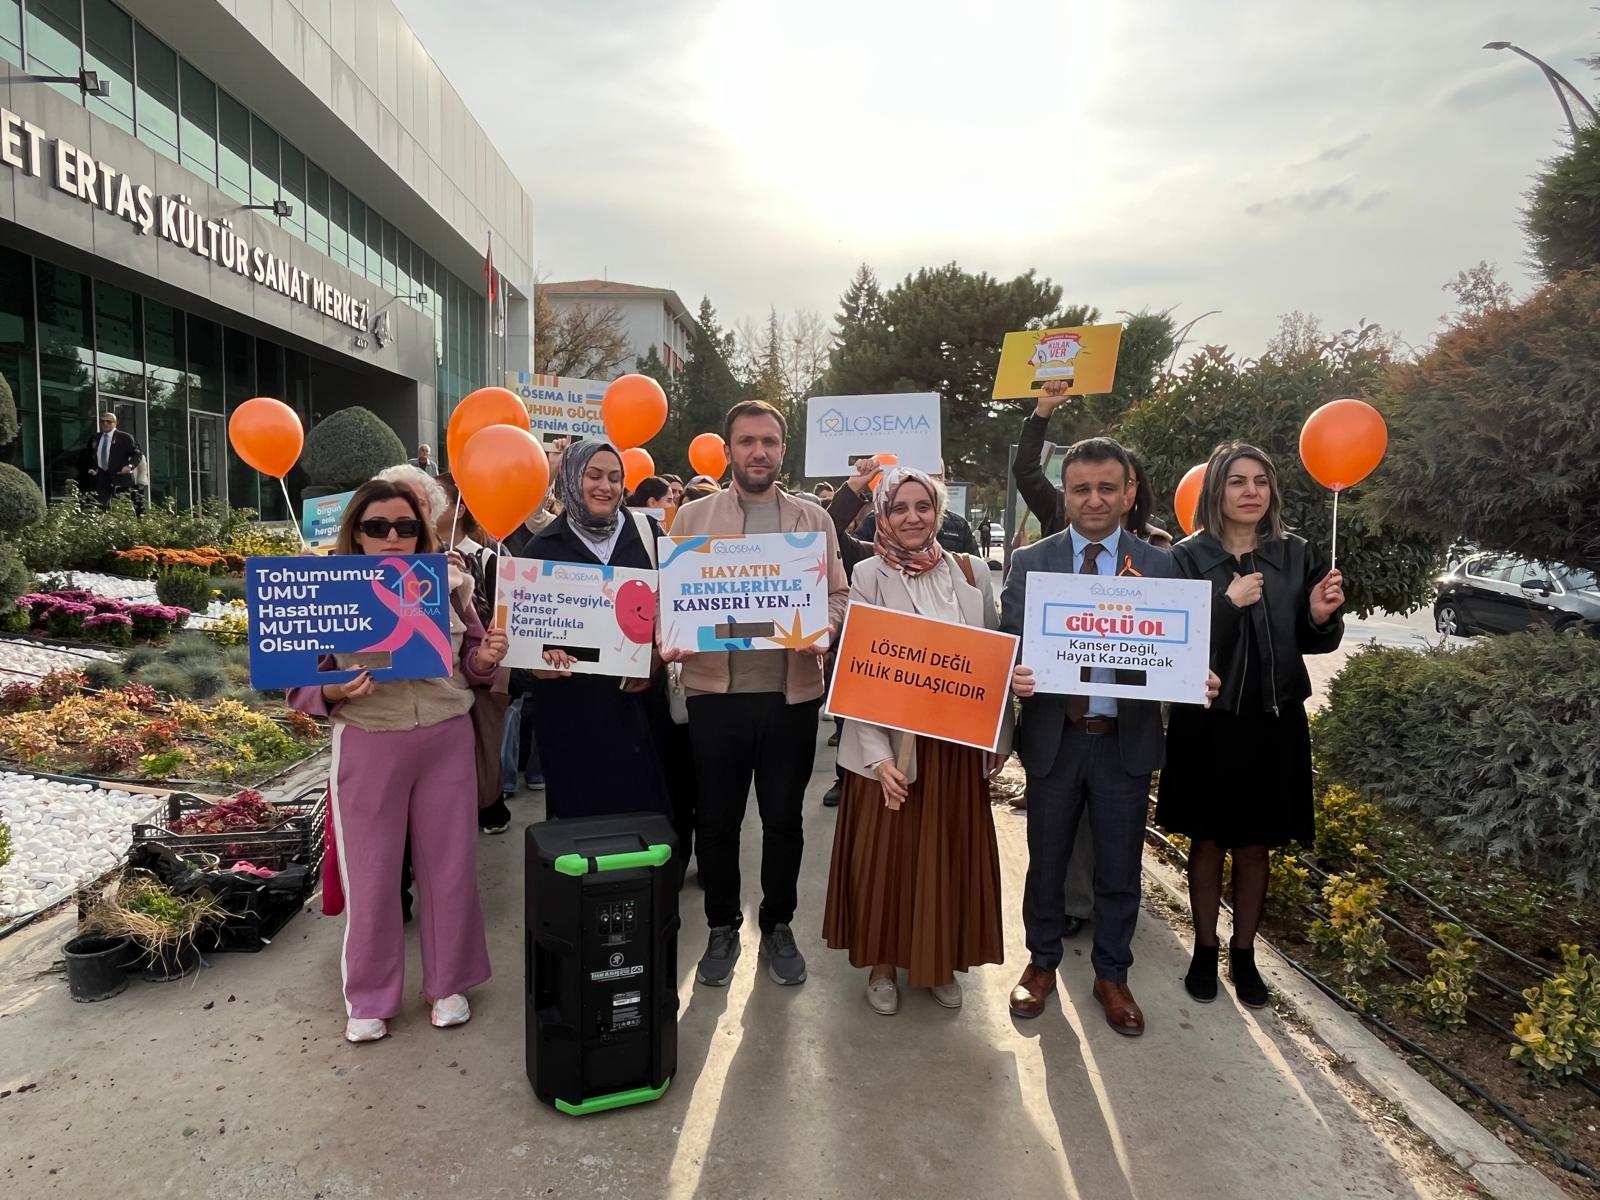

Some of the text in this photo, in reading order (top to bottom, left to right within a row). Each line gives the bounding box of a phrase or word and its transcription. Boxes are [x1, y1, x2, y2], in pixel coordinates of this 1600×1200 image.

[0, 107, 370, 333] ET ERTAŞ KÜLTÜR SANAT MERKEZİ
[1050, 348, 1067, 358] VER
[516, 385, 583, 403] LÖSEMA İLE
[525, 404, 603, 421] UHUM GÜÇL
[530, 418, 568, 432] DENİM
[256, 568, 385, 583] Tohumumuz
[701, 564, 781, 579] HAYATIN
[257, 585, 320, 601] UMUT
[681, 577, 802, 596] RENKLERİYLE
[513, 589, 614, 609] Hayat Sevgiyle,
[673, 593, 811, 612] KANSERİ YEN...!
[258, 603, 359, 618] Hasatımız
[512, 602, 558, 615] Kanser
[259, 617, 373, 635] MUTLULUK
[511, 613, 584, 629] Kararlılıkla
[1065, 612, 1166, 638] GÜÇLÜ OL
[510, 625, 567, 640] Yenilir...!
[259, 638, 335, 652] Olsun...
[1069, 639, 1158, 656] Kanser Değil,
[870, 639, 972, 674] LÖSEMİ DEĞİL
[1056, 650, 1173, 668] Hayat Kazanacak
[850, 657, 986, 701] İYİLİK BULAŞICIDIR
